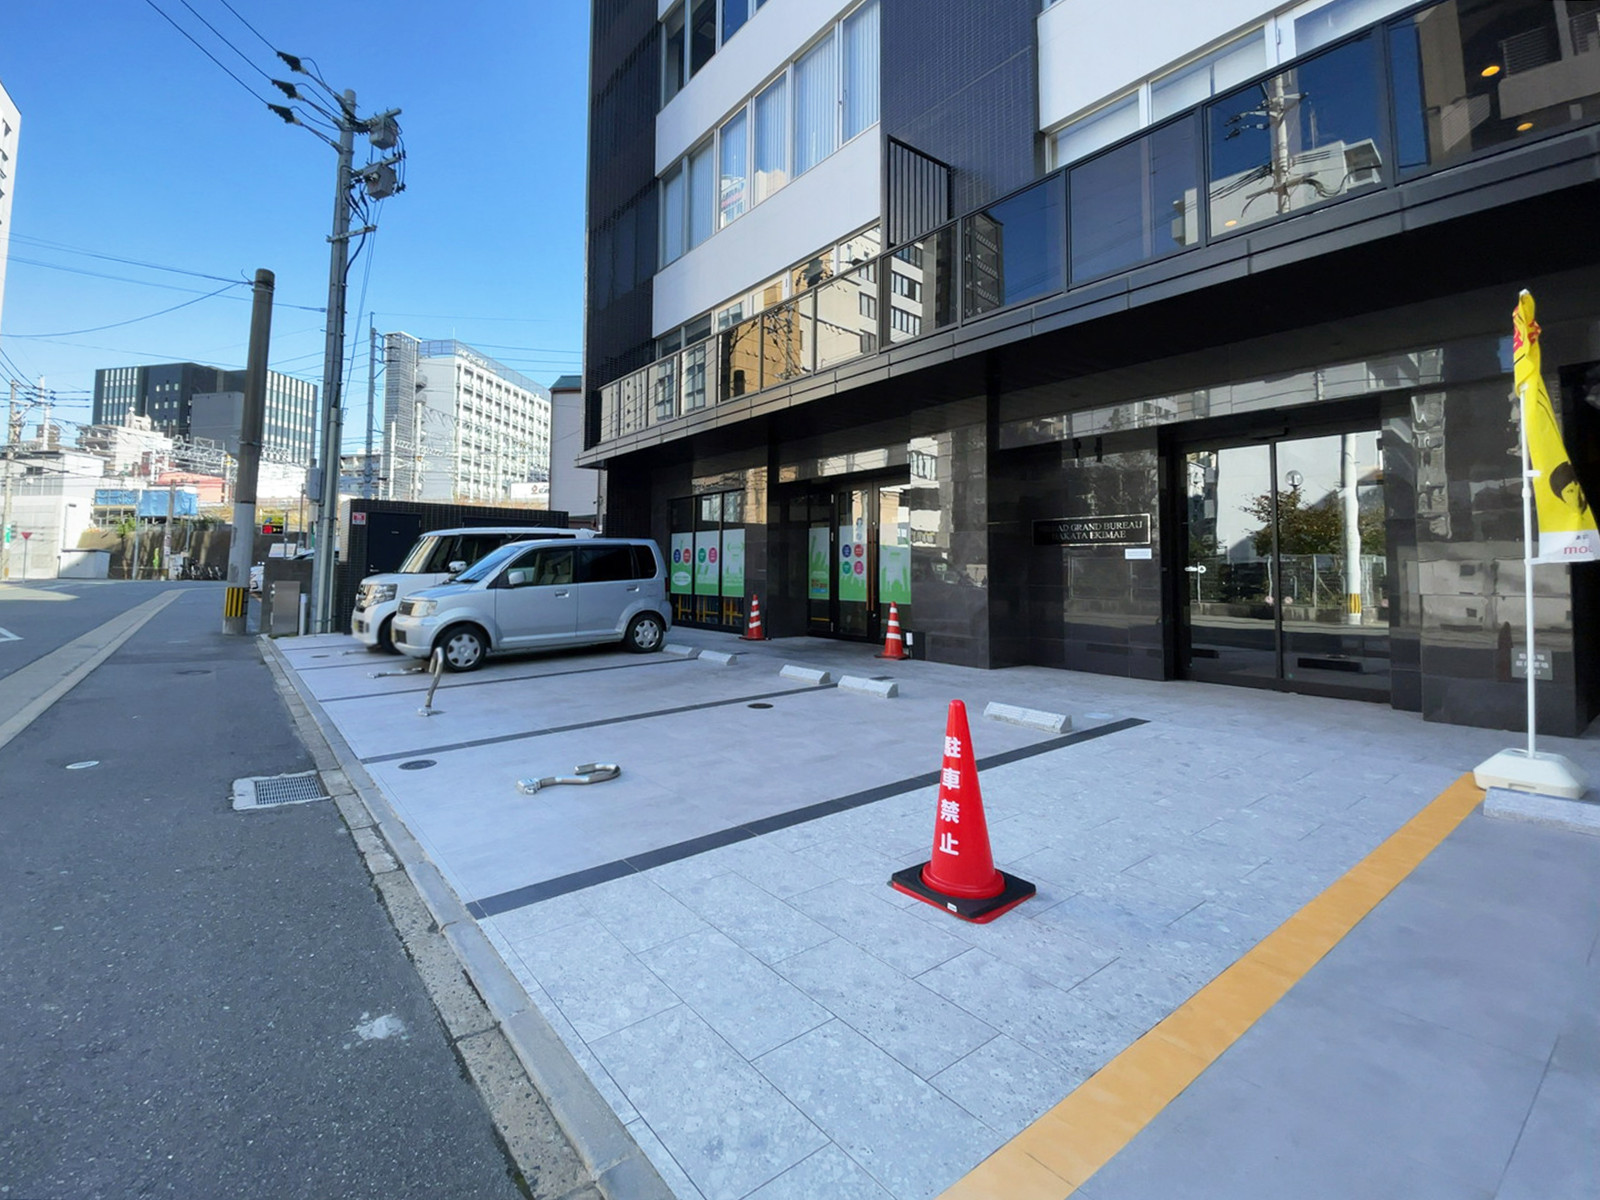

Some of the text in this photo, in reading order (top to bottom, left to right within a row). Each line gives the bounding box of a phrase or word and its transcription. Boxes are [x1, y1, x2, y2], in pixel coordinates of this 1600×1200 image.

[1071, 522, 1102, 532] GRAND
[1104, 520, 1143, 531] BUREAU
[1089, 530, 1127, 540] EKIMAE
[939, 735, 961, 856] 駐車禁止
